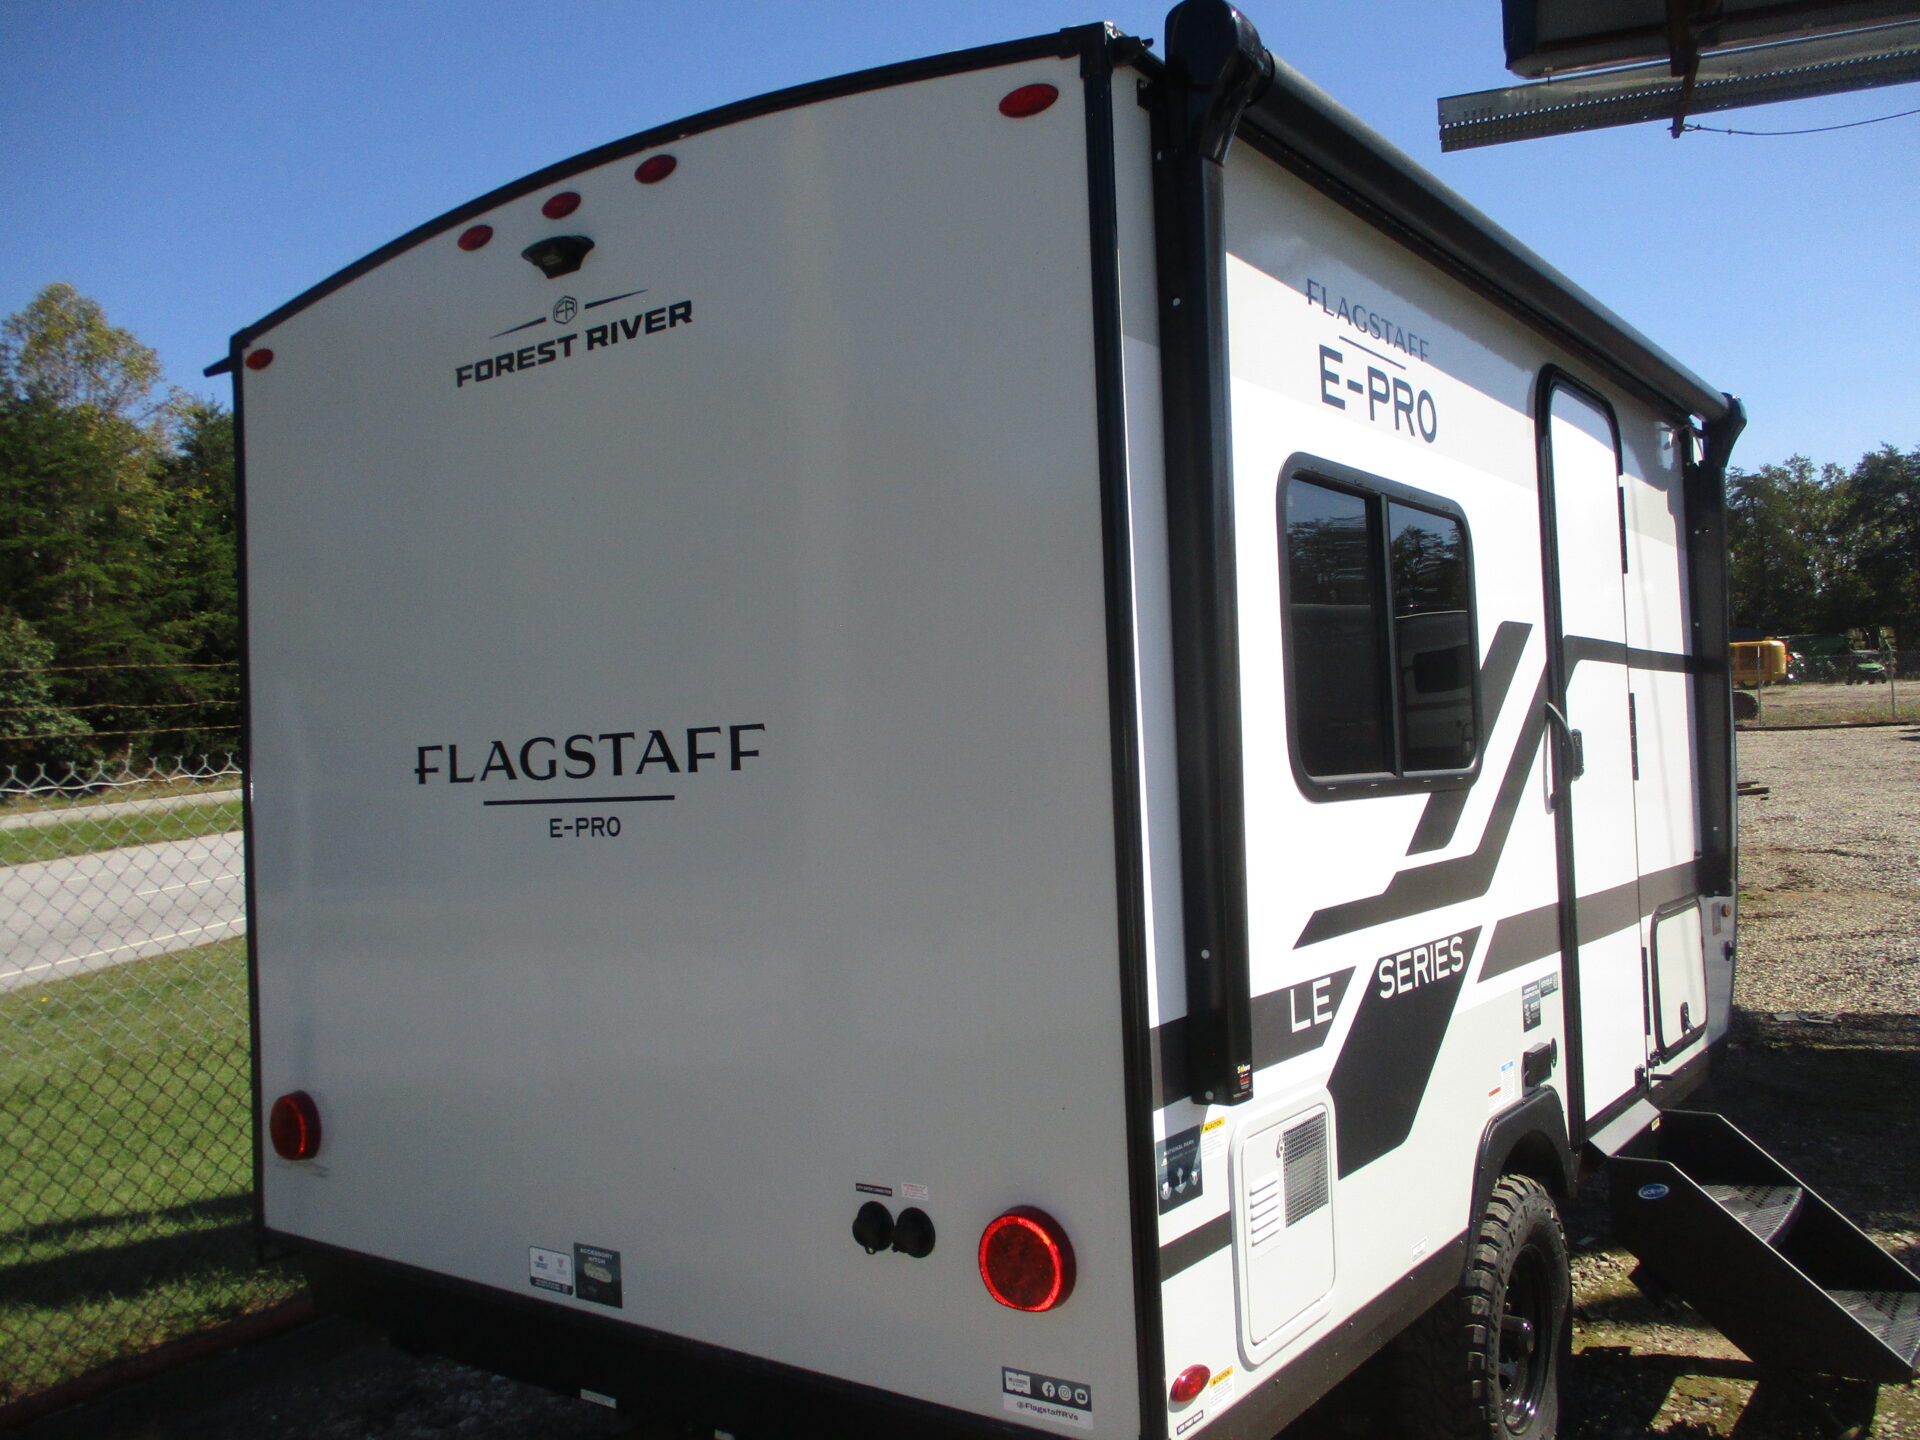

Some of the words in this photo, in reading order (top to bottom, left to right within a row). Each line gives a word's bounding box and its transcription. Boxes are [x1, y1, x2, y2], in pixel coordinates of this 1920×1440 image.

[455, 333, 578, 388] FOREST
[585, 300, 693, 351] RIVER
[1306, 278, 1429, 362] FLAGSTAFF
[1318, 343, 1437, 443] E-PRO
[414, 723, 766, 785] FLAGSTAFF
[549, 816, 621, 838] E-PRO
[1290, 977, 1333, 1033] LE
[1378, 936, 1463, 999] SERIES
